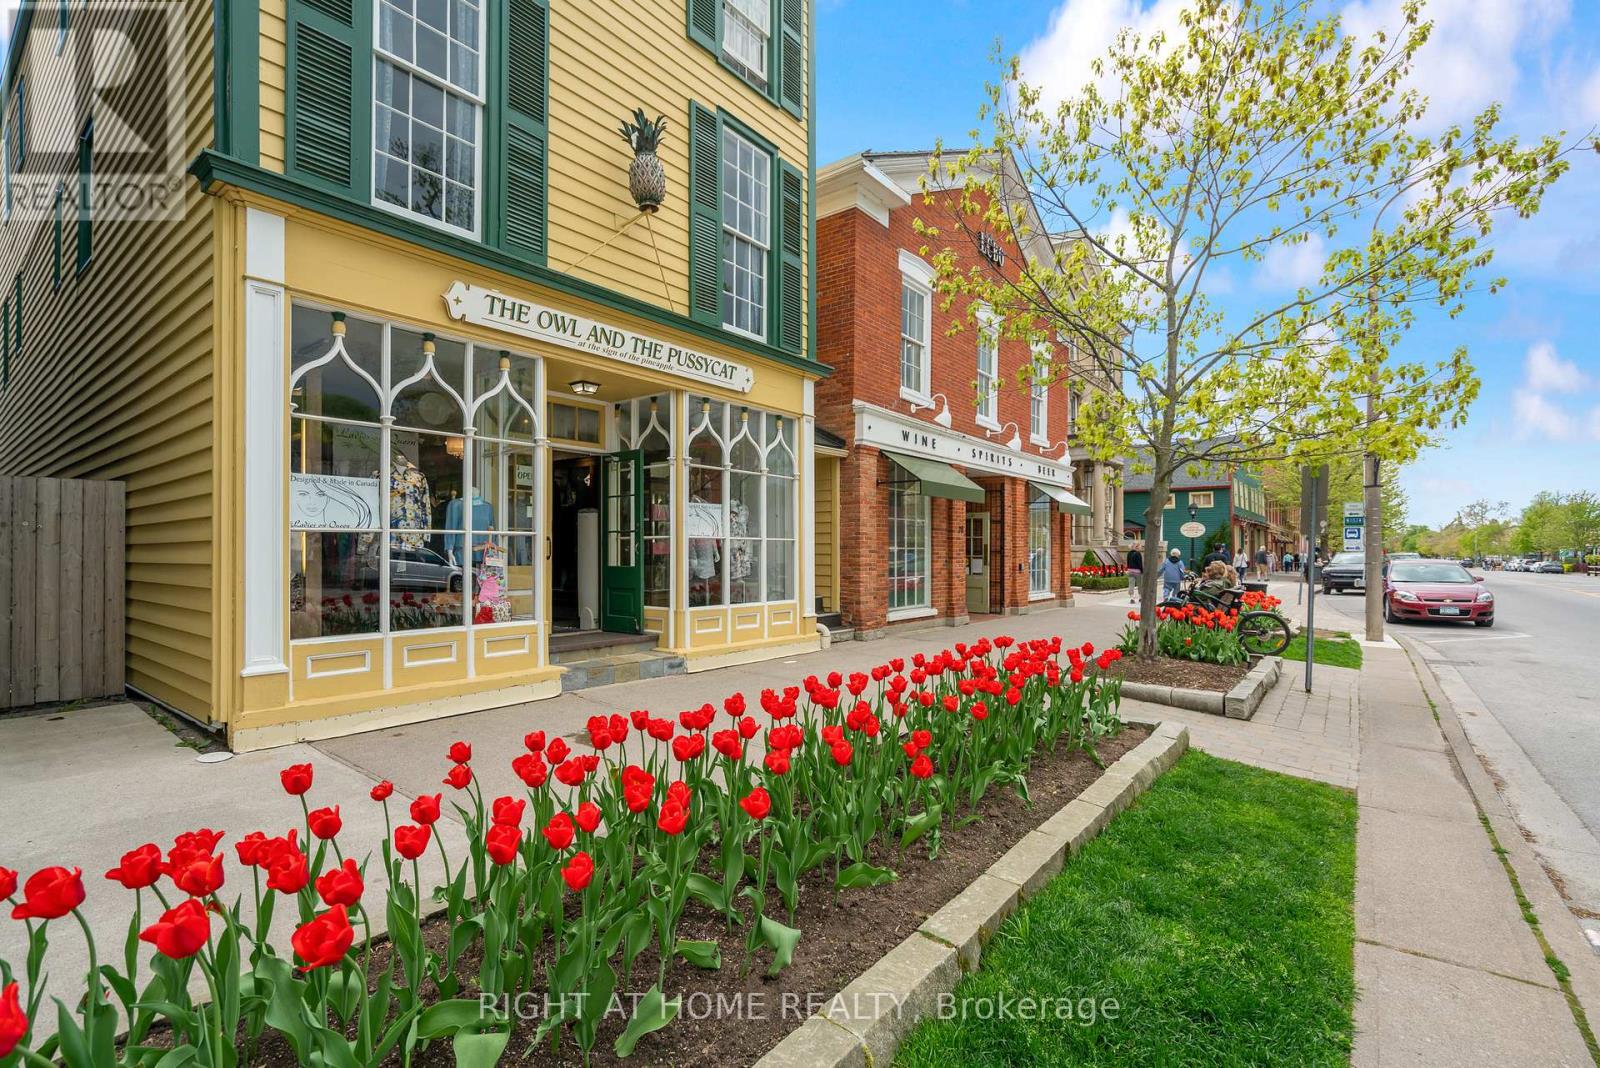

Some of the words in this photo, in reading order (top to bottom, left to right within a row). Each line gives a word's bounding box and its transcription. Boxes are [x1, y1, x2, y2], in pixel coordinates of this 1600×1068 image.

[484, 294, 531, 324] THE
[537, 310, 581, 338] OWL
[586, 325, 625, 349] AND
[631, 336, 664, 360] THE
[667, 347, 737, 380] PUSSYCAT
[587, 343, 601, 352] the
[602, 347, 618, 356] sign
[619, 351, 628, 359] of
[628, 353, 640, 362] the
[640, 358, 674, 371] pineapple
[902, 430, 937, 450] WINE
[972, 448, 1012, 467] SPIRITS
[1038, 465, 1056, 477] BEER
[291, 475, 320, 485] Designed
[356, 479, 378, 487] Canada
